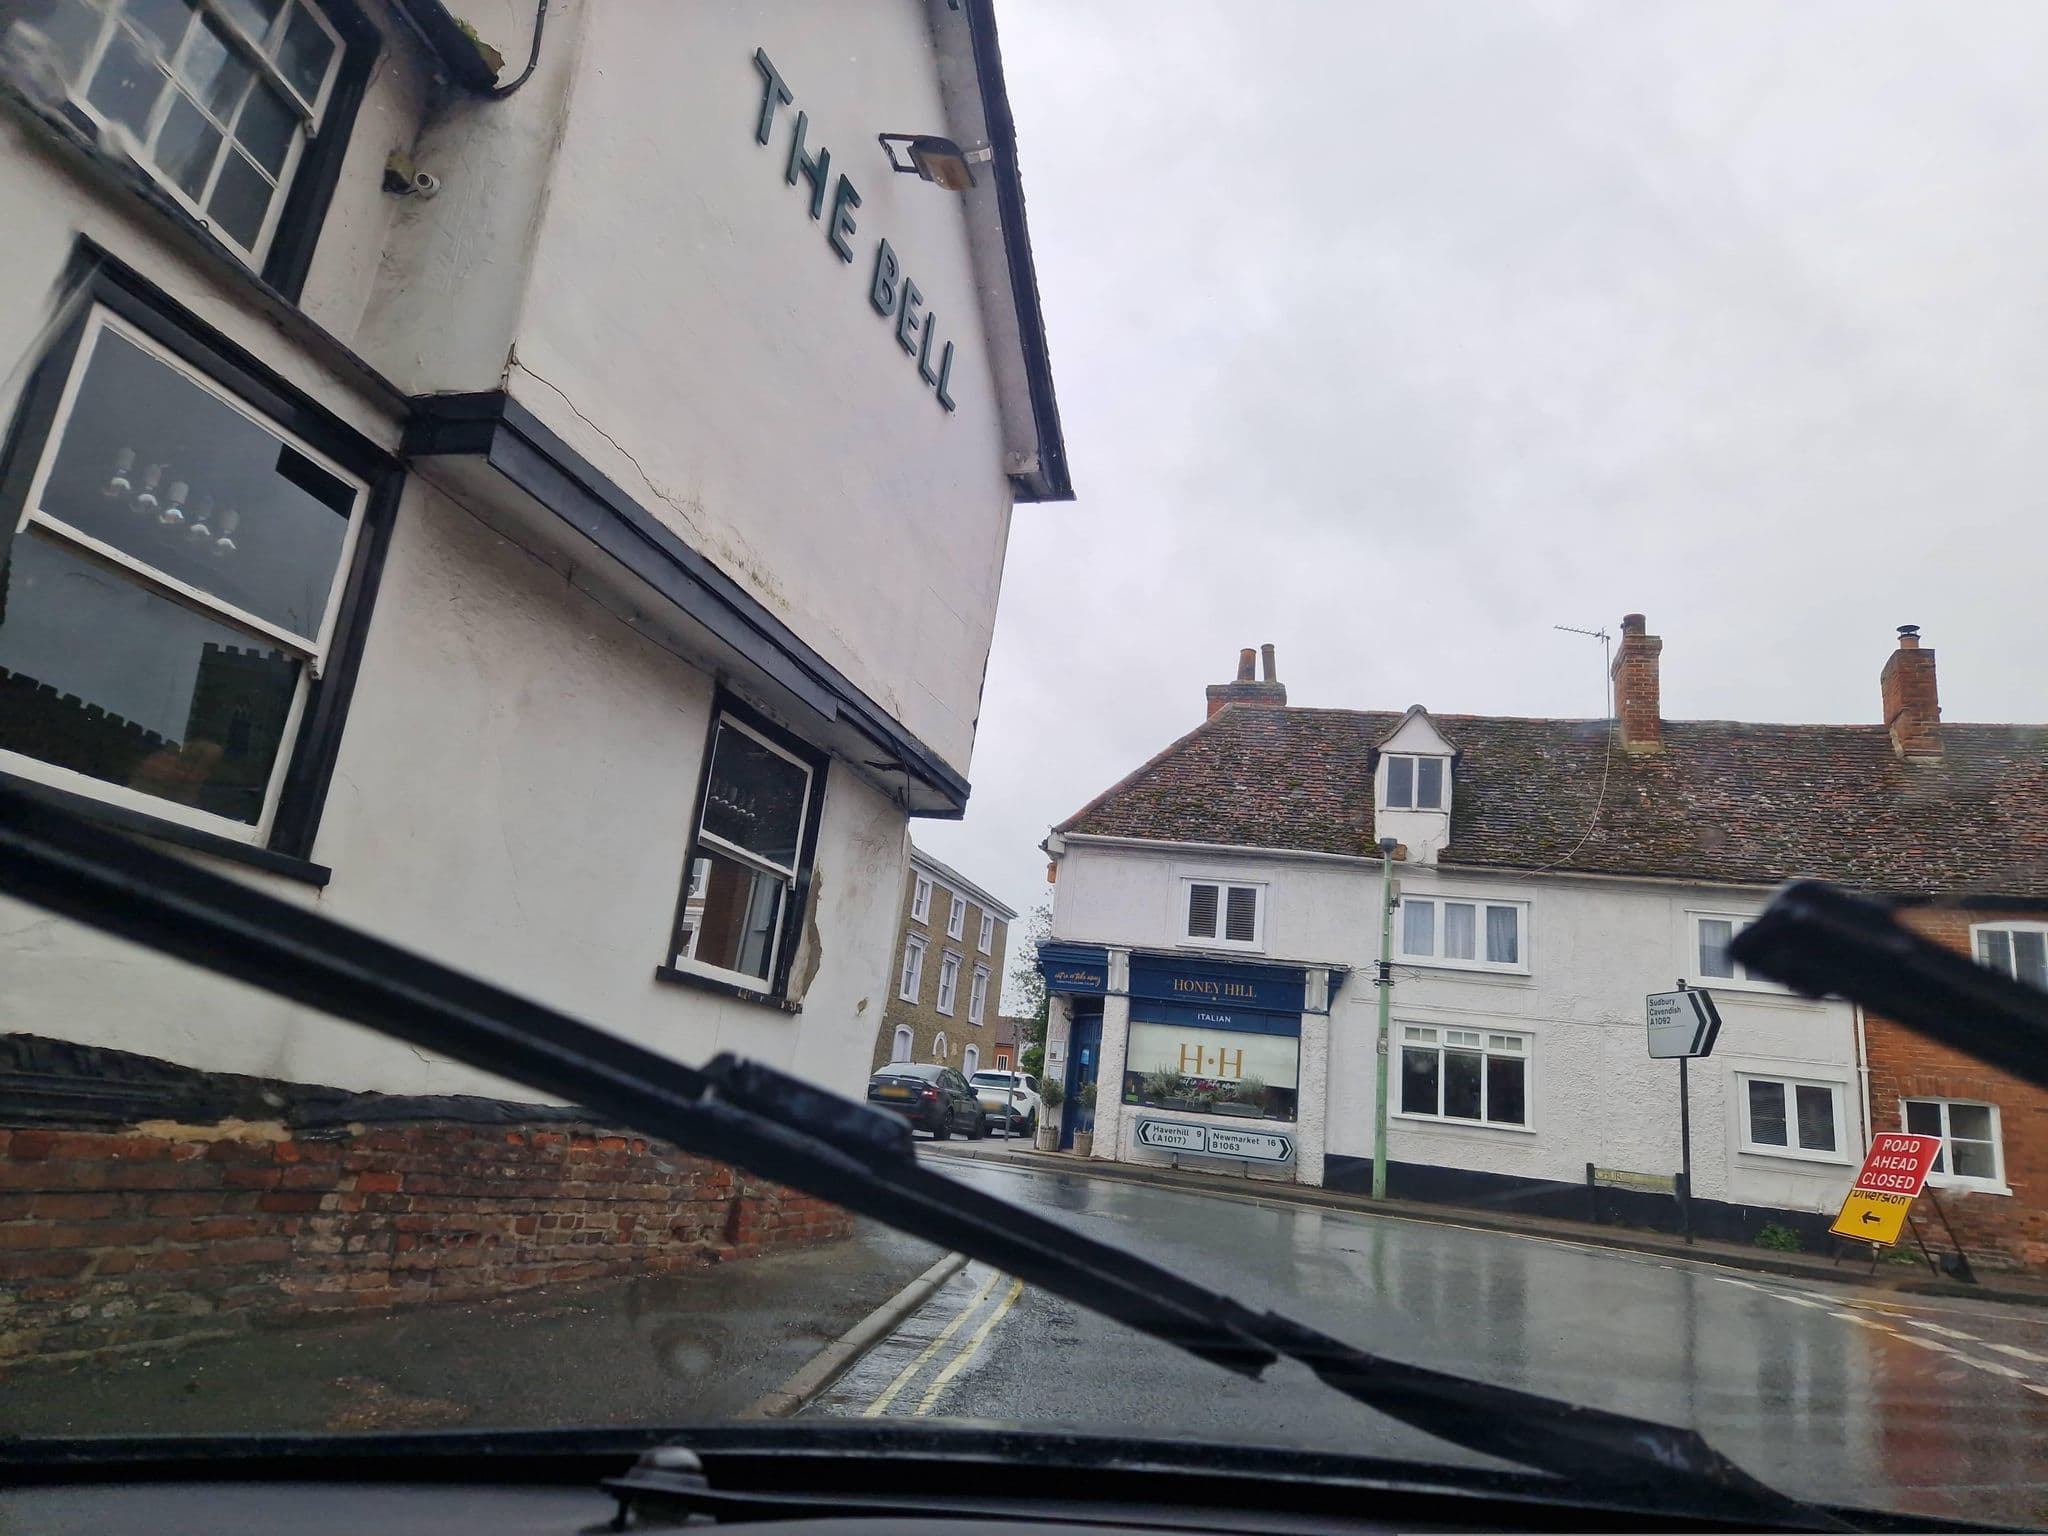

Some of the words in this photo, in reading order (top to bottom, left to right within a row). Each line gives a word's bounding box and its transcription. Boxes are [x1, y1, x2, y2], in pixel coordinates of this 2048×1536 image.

[754, 46, 863, 264] THE
[870, 237, 956, 412] BELL
[1174, 979, 1220, 994] HONEY
[1224, 983, 1256, 997] HILL
[1649, 999, 1676, 1007] Sudbury
[1649, 1006, 1682, 1016] Cavendish
[1197, 1013, 1231, 1023] ITALIAN
[1650, 1016, 1671, 1025] A1092
[1153, 1126, 1189, 1137] Haverhill
[1196, 1130, 1202, 1138] 9
[1152, 1133, 1187, 1145] (A1017)
[1213, 1133, 1260, 1145] Newmarket
[1267, 1139, 1277, 1147] 16
[1213, 1142, 1240, 1151] B1063
[1882, 1139, 1920, 1153] ROAD
[1871, 1156, 1918, 1171] AHEAD
[1862, 1172, 1915, 1190] CLOSED
[1853, 1190, 1906, 1206] Diversion
